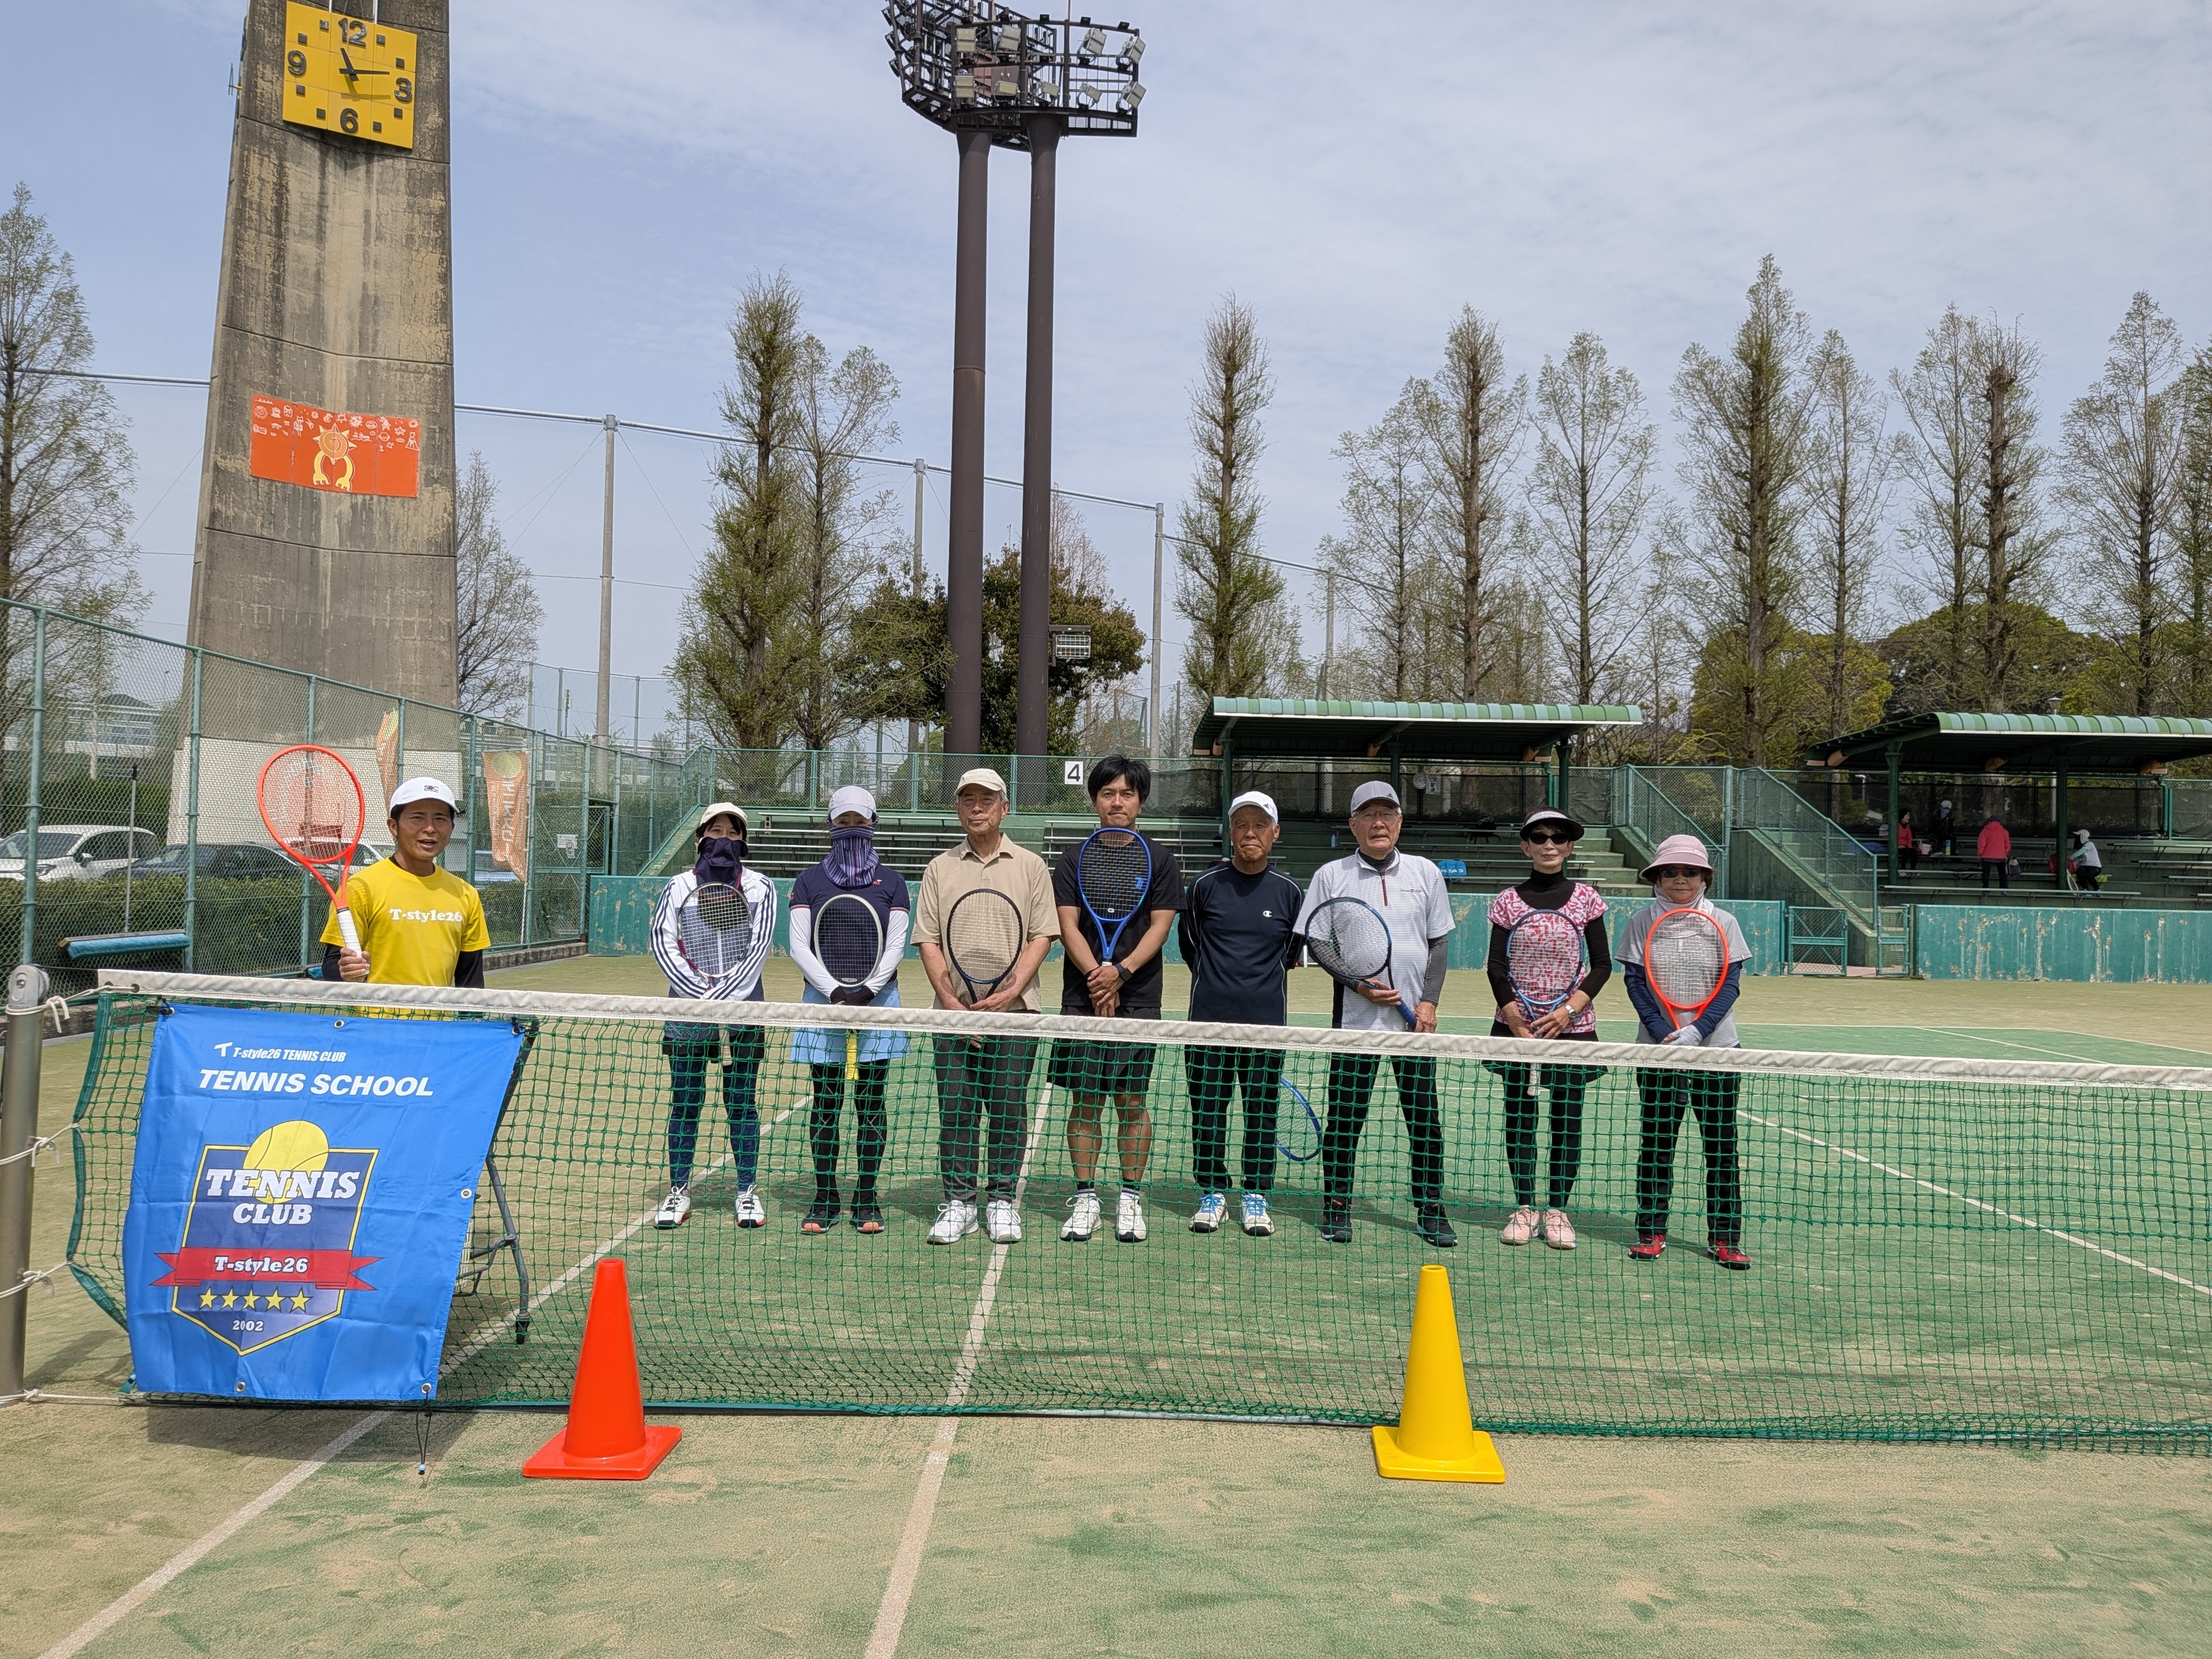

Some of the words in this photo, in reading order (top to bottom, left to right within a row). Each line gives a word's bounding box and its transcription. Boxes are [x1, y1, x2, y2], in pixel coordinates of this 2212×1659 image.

[338, 18, 367, 47] 12
[288, 50, 307, 76] 9
[394, 77, 412, 102] 3
[340, 108, 358, 133] 6
[1067, 764, 1081, 782] 4
[389, 909, 463, 923] T-style26
[233, 1047, 281, 1060] T-style26
[283, 1049, 320, 1061] TENNIS
[320, 1051, 347, 1062] CLUB
[199, 1069, 306, 1093] TENNIS
[310, 1075, 434, 1096] SCHOOL
[205, 1168, 361, 1199] TENNIS
[232, 1203, 314, 1225] CLUB
[215, 1256, 309, 1275] T-style26
[232, 1320, 264, 1332] 2002
